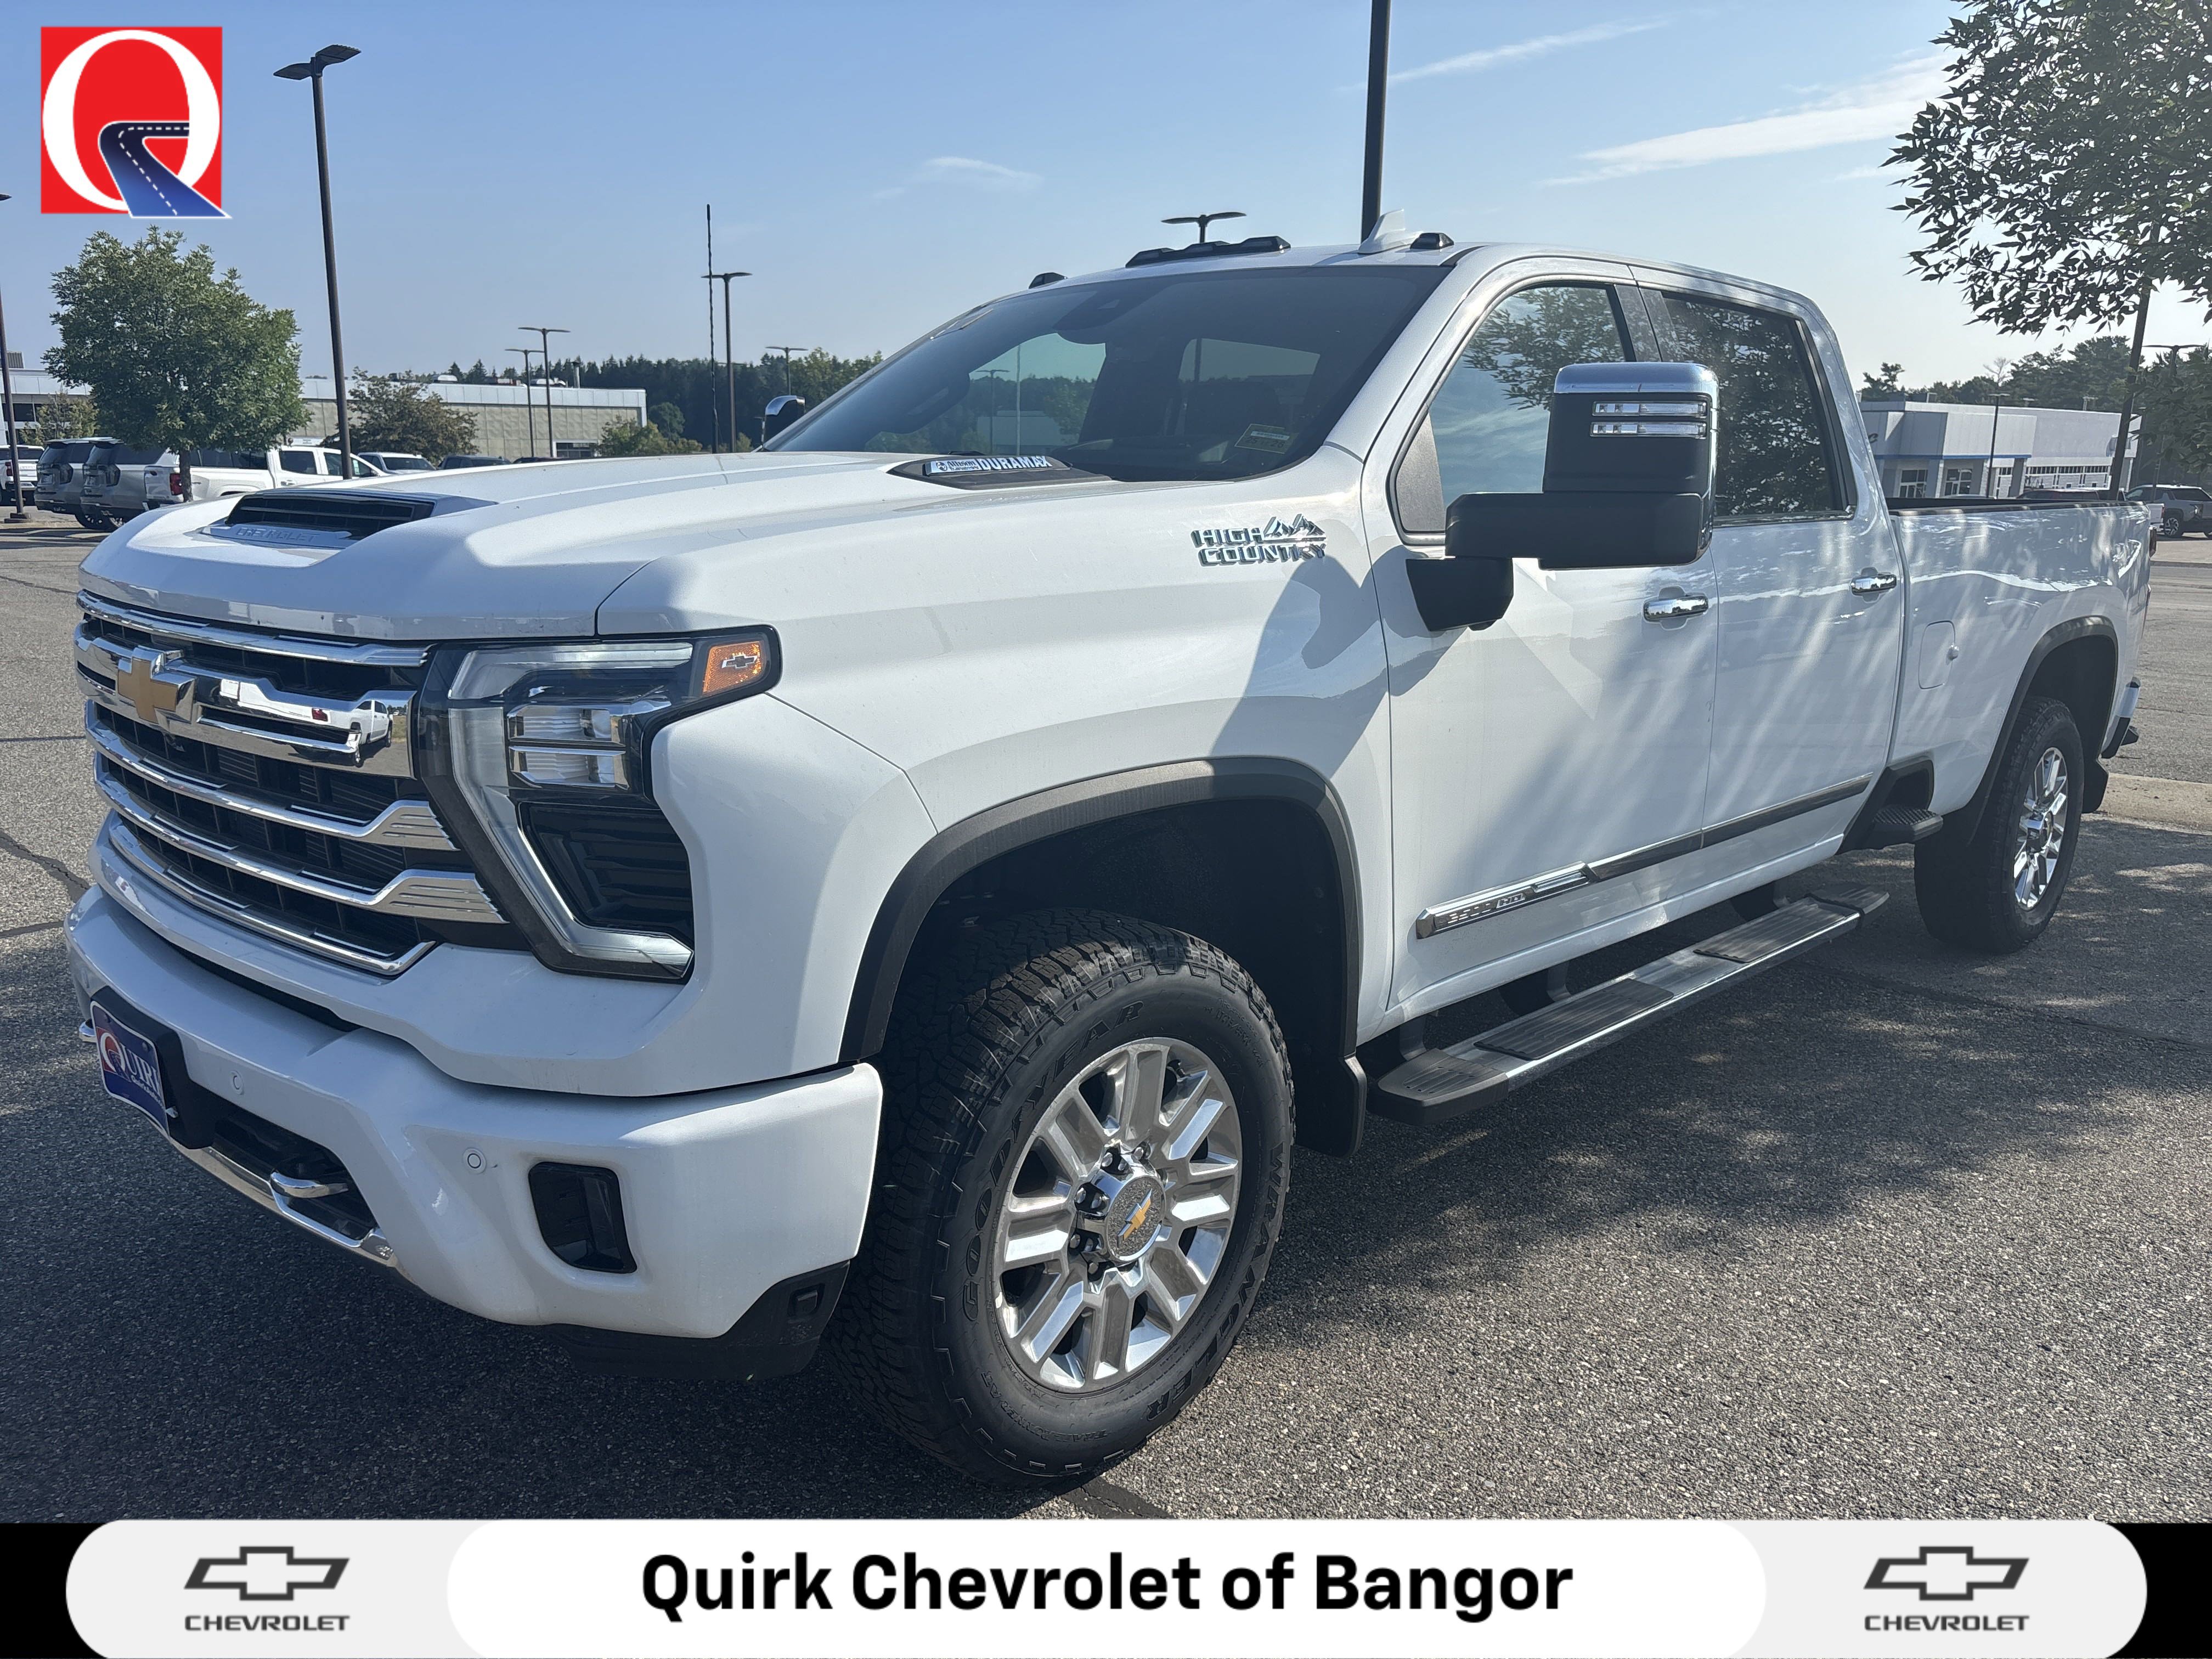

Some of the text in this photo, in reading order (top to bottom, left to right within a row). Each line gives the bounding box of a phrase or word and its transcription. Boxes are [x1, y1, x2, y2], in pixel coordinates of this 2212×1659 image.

[977, 455, 1053, 471] DURAMAX
[1190, 527, 1263, 548] HIGH
[1198, 543, 1327, 567] COUNTRY
[1496, 892, 1526, 909] HD
[963, 1000, 1144, 1322] GOODYEAR
[1147, 1141, 1285, 1421] WRANGLER
